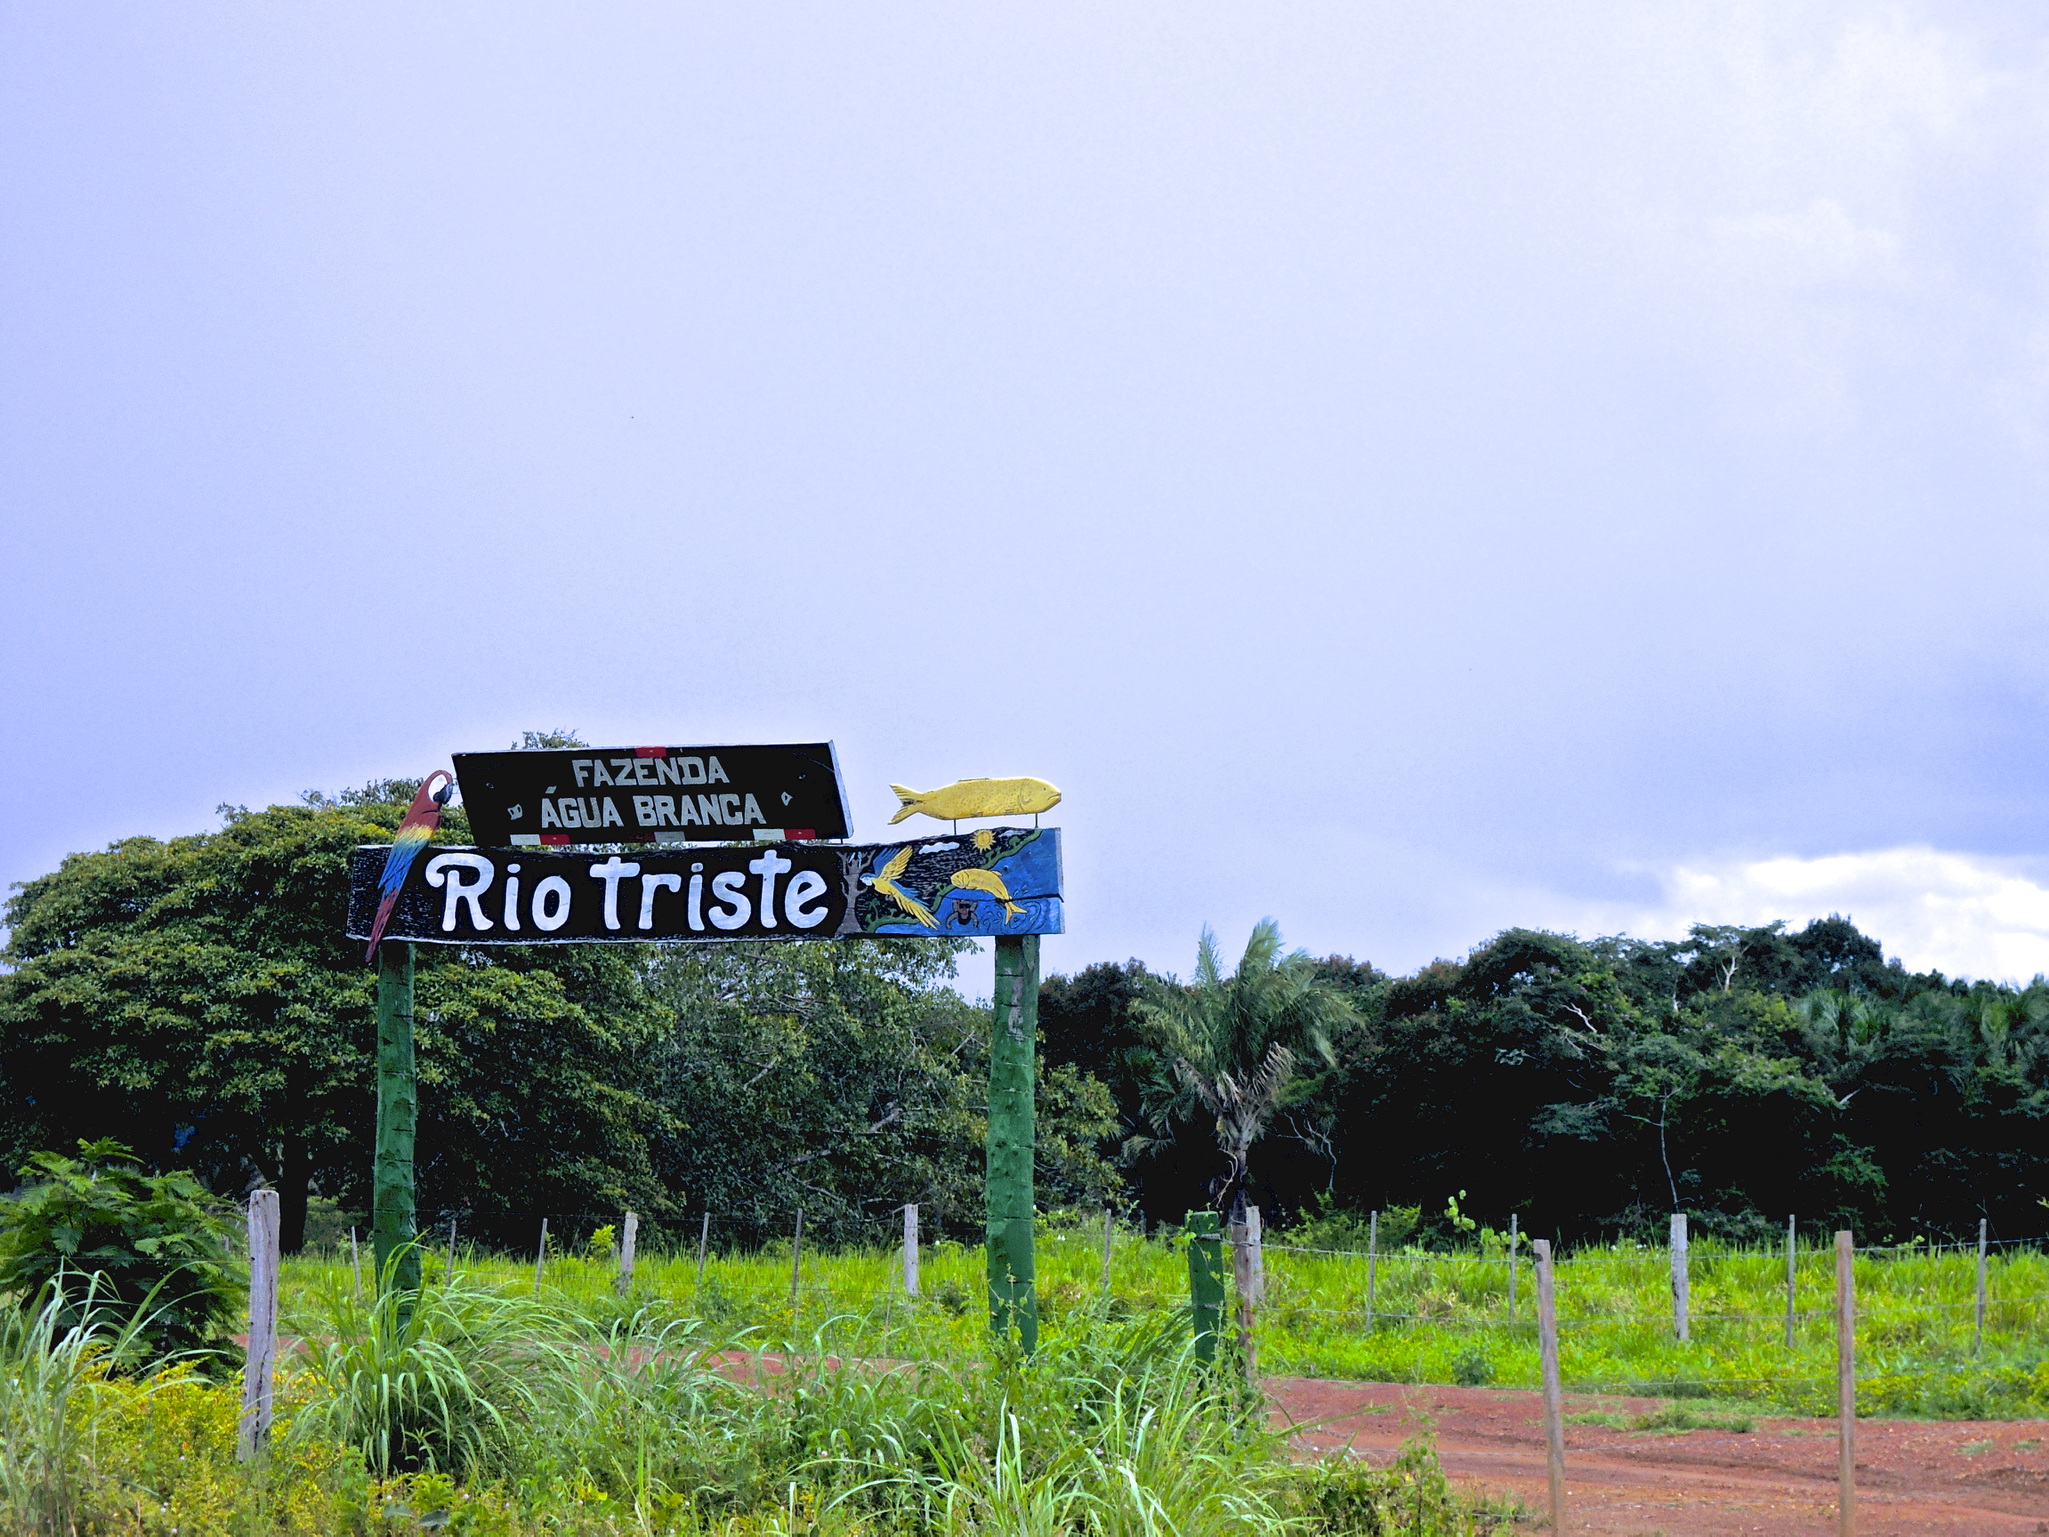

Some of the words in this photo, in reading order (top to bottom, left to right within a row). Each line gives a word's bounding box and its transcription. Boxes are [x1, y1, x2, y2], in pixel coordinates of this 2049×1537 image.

[572, 756, 730, 787] FAZENDA
[541, 786, 624, 828] ÁGUA
[632, 793, 767, 826] BRANCA
[425, 853, 572, 931] Rio
